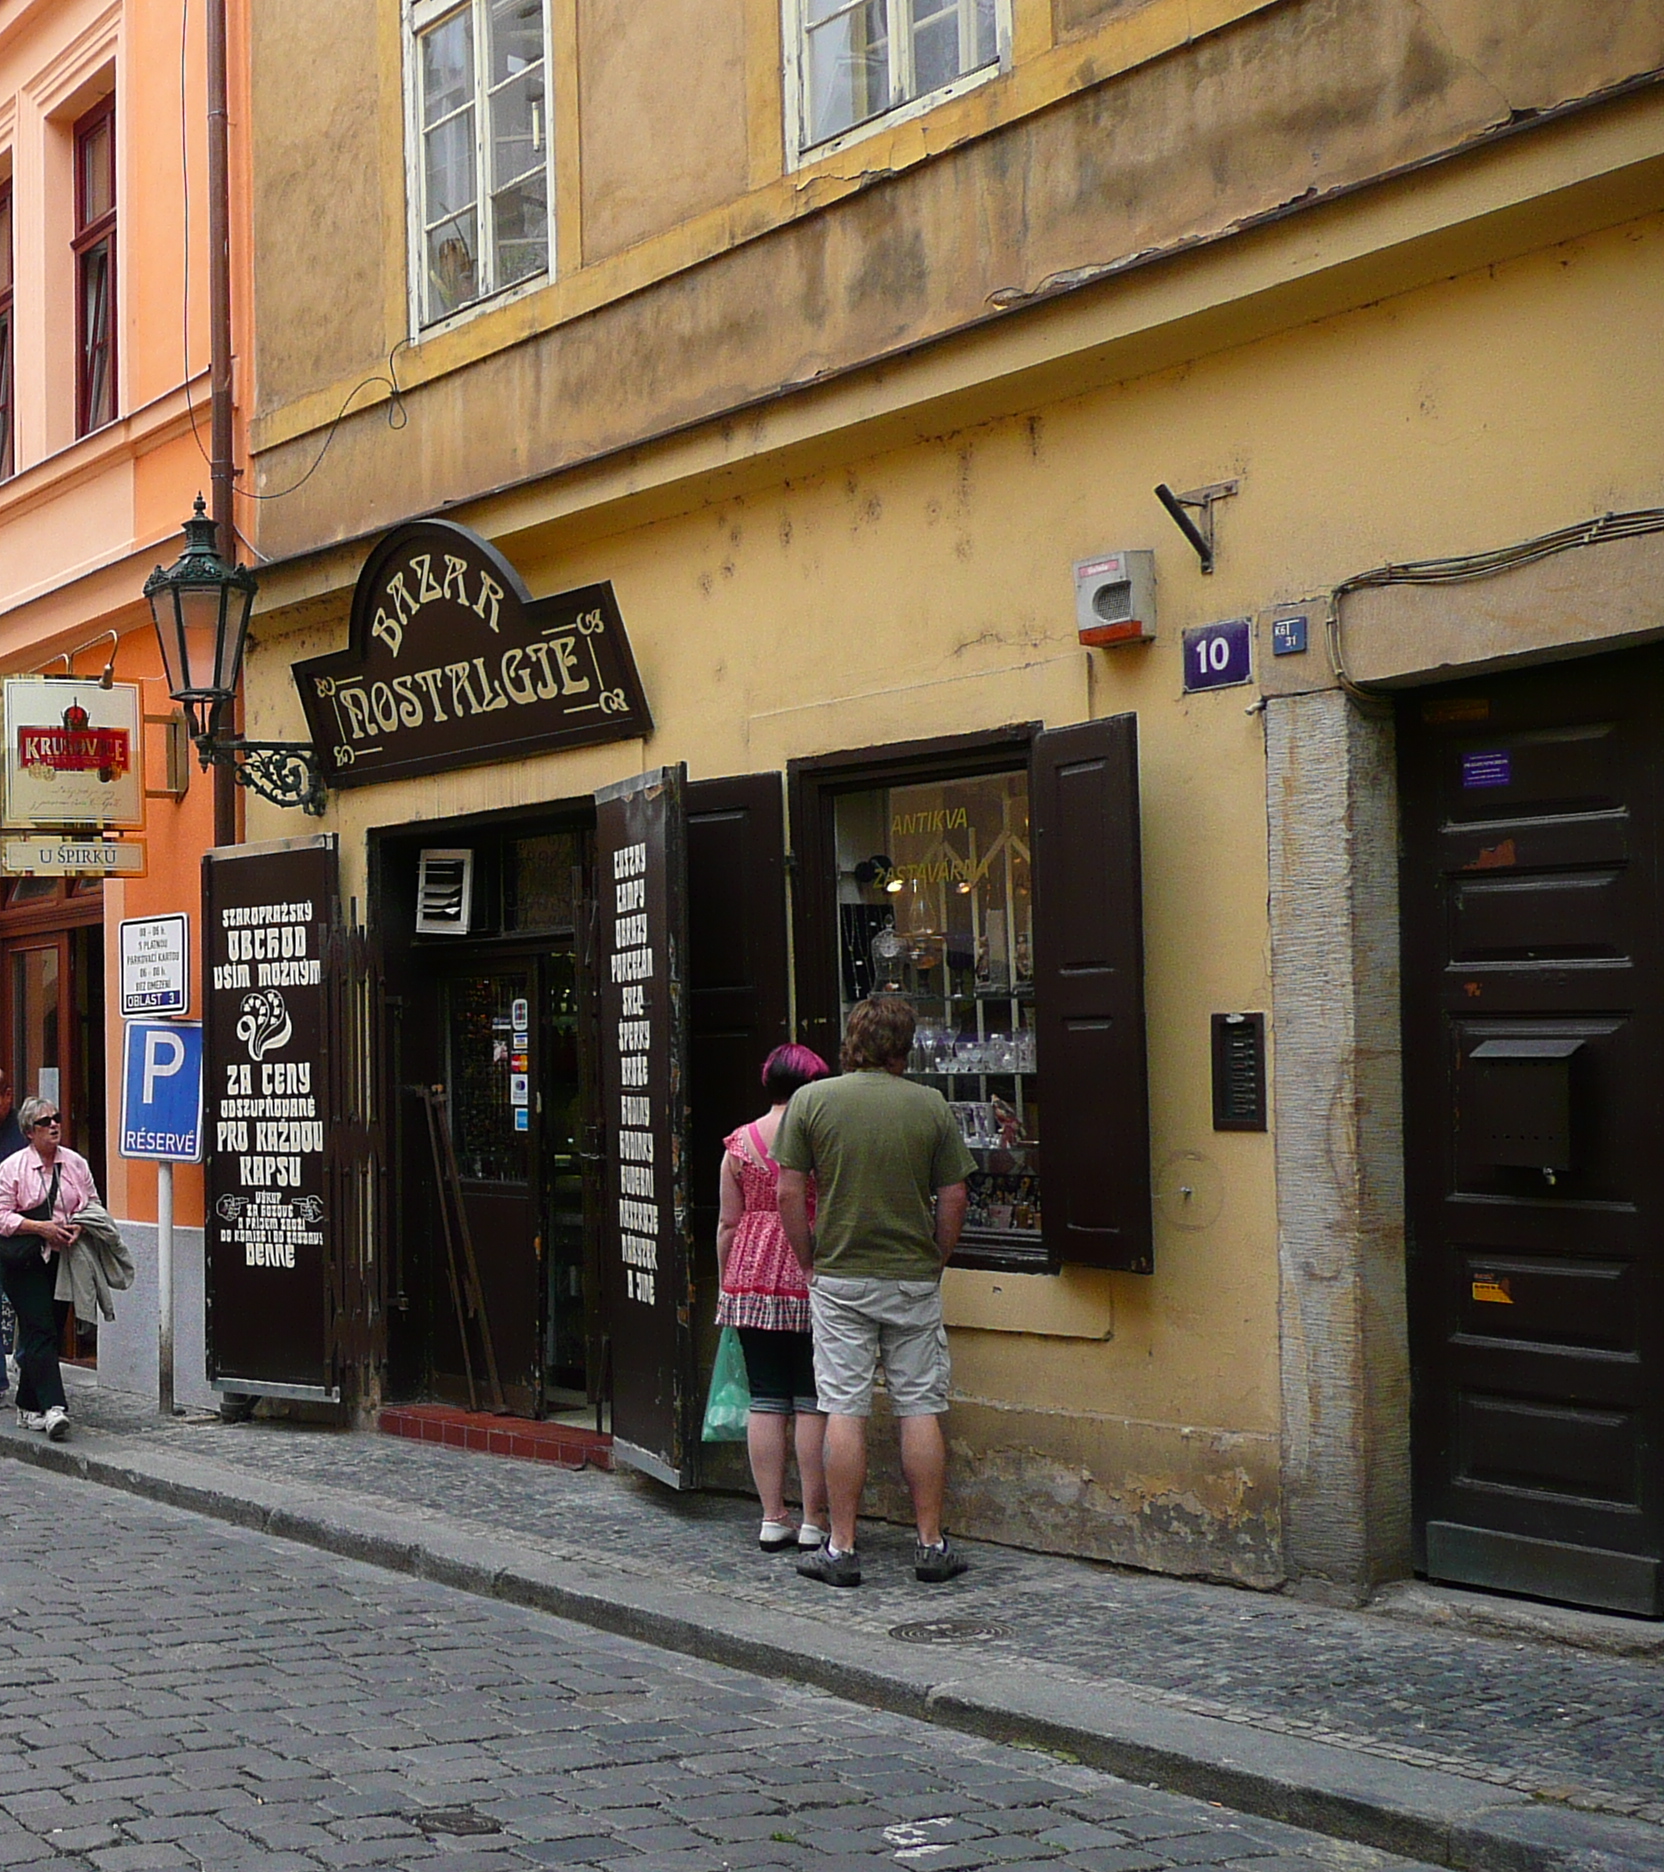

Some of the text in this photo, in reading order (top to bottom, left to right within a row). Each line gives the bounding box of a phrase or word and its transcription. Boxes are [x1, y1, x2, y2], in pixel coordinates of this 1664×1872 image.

[371, 553, 505, 659] BAZAR
[1196, 636, 1230, 674] 10
[890, 806, 968, 836] ANTIKVA
[40, 849, 53, 864] U
[613, 842, 646, 879] LUSTRY
[616, 878, 645, 914] LAMPY
[221, 899, 313, 928] STAROPRAŽSKÝ
[143, 939, 168, 950] PLATNOU
[227, 926, 307, 961] OBCHOD
[615, 913, 648, 949] OBRAZY
[158, 951, 180, 962] KARTOU
[257, 958, 321, 988] MOŽNÝM
[610, 945, 653, 983] PORCELÁN
[127, 992, 175, 1007] OBLAST 3
[622, 985, 644, 1017] SKLO
[618, 1018, 650, 1052] ŠPERKY
[142, 1030, 185, 1104] P
[226, 1062, 311, 1095] ZA CENY
[621, 1052, 648, 1087] BROŽE
[220, 1094, 316, 1118] ODSTUPŇOVANÉ
[621, 1095, 650, 1127] HODINY
[126, 1126, 196, 1153] RÉSERVÉ
[217, 1118, 324, 1153] PRO KAŽDOU
[619, 1129, 654, 1163] HODINKY
[239, 1155, 302, 1187] KAPSU
[620, 1164, 655, 1199] HUDEBNÍ
[246, 1204, 258, 1217] ZA
[619, 1195, 659, 1235] NÁSTROJE
[220, 1229, 231, 1242] DO
[234, 1229, 266, 1242] KOMISE
[272, 1230, 284, 1243] DO
[621, 1230, 658, 1271] NÁBYTEK
[627, 1269, 655, 1306] A JINÉ
